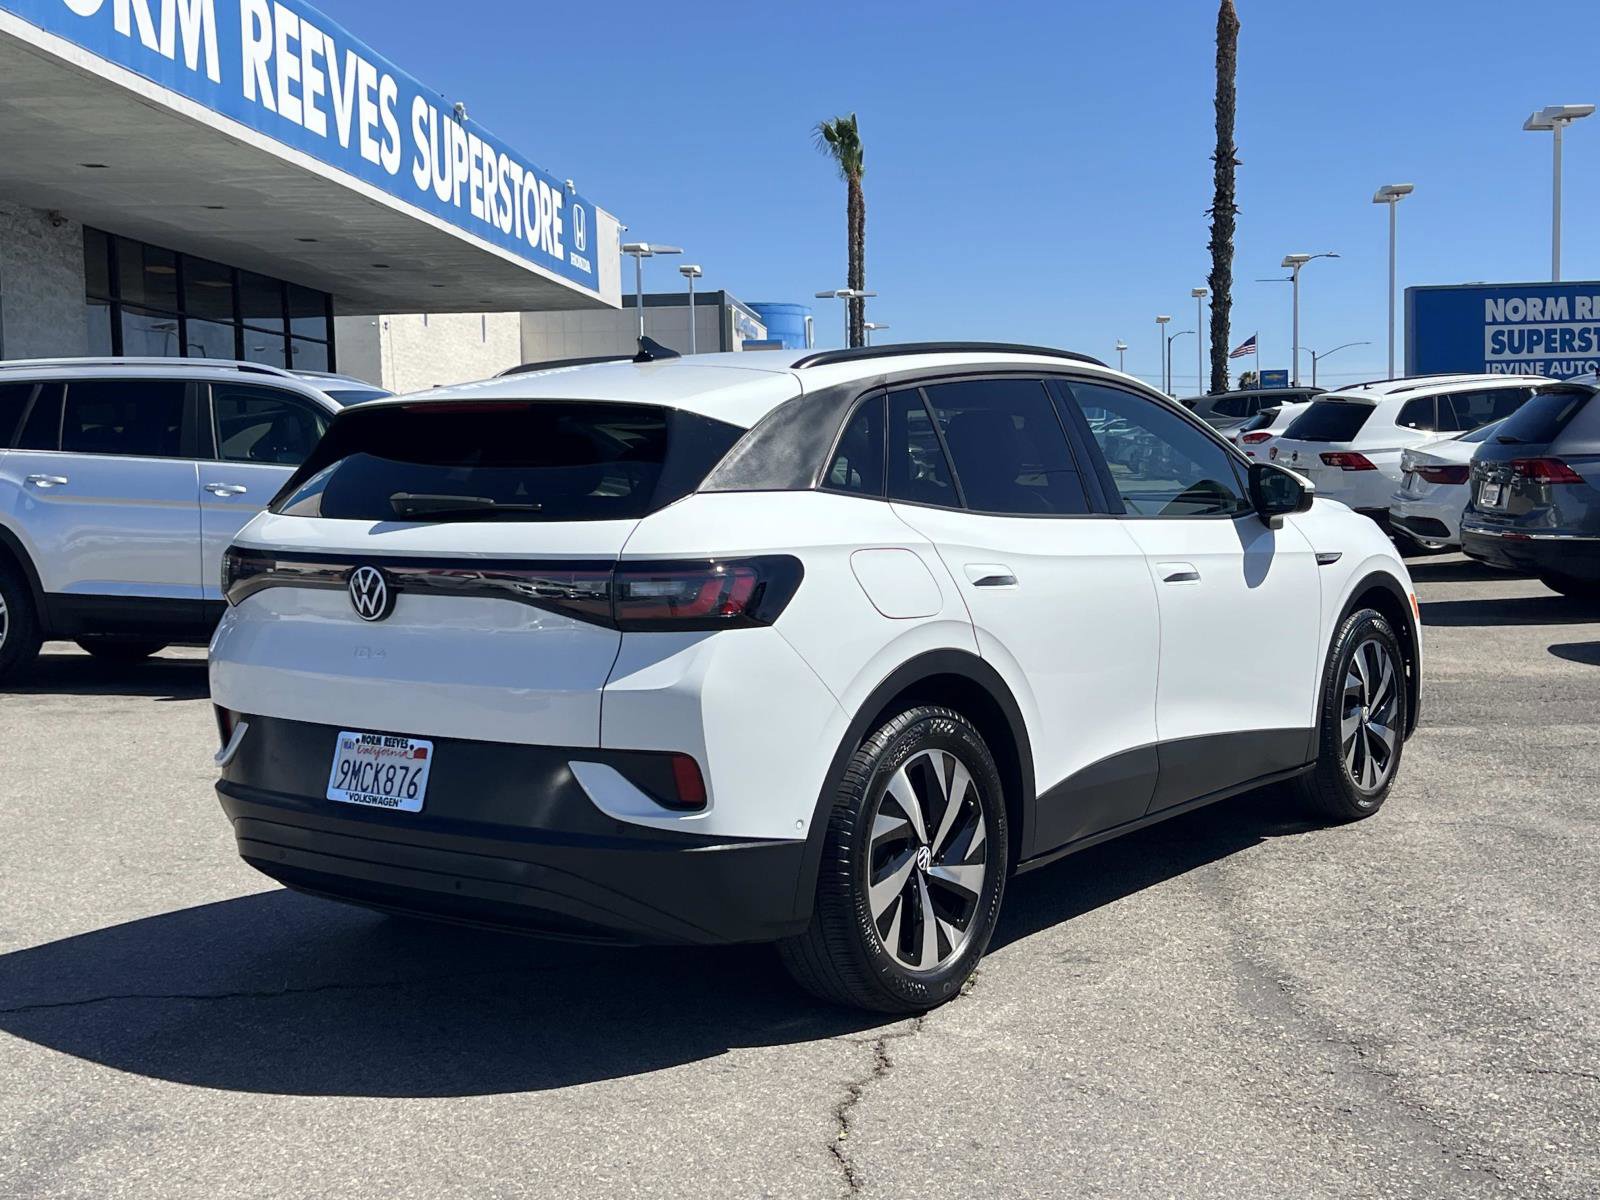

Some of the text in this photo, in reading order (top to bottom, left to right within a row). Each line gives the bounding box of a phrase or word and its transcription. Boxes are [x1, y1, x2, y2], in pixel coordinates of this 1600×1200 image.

[240, 0, 400, 175] REEVES
[412, 95, 564, 261] SUPERSTORE
[1485, 297, 1570, 322] NORM
[1485, 361, 1545, 375] IRVINE
[361, 734, 382, 746] NORM
[384, 736, 409, 749] REEVES
[336, 759, 423, 799] 9MCK876
